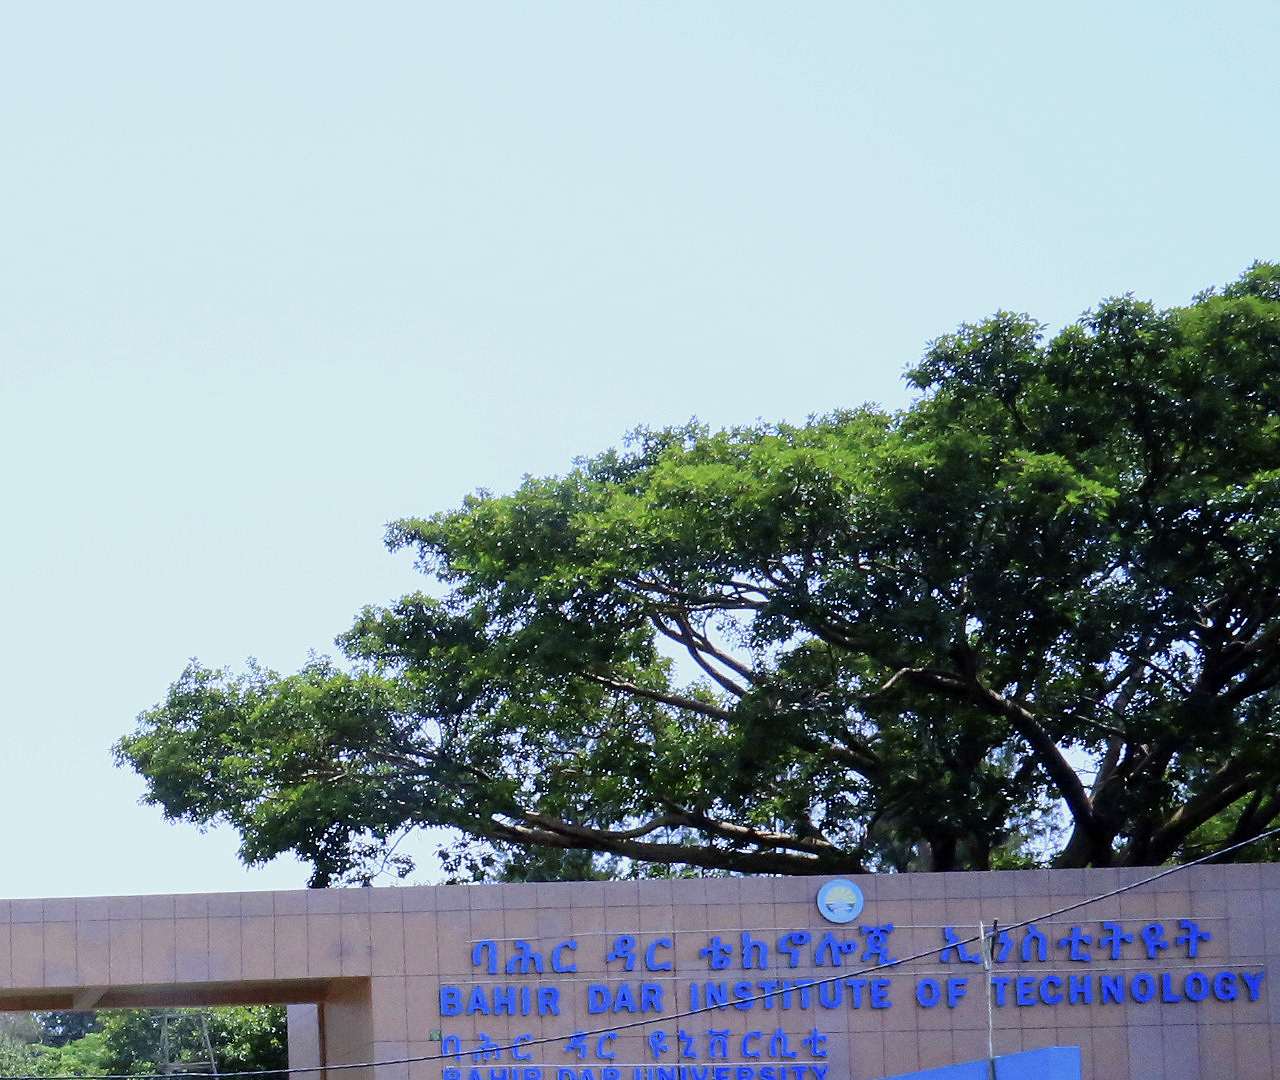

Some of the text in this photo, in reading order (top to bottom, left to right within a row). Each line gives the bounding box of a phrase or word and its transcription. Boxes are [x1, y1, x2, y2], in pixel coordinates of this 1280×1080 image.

[472, 940, 578, 974] ባሕር
[607, 936, 672, 971] ዳር
[440, 971, 1265, 1016] BAHIR DAR INSTITUTE OF TECHNOLOGY
[565, 1030, 618, 1059] ዳር
[648, 1028, 829, 1059] ዩኒቨርሲቲ
